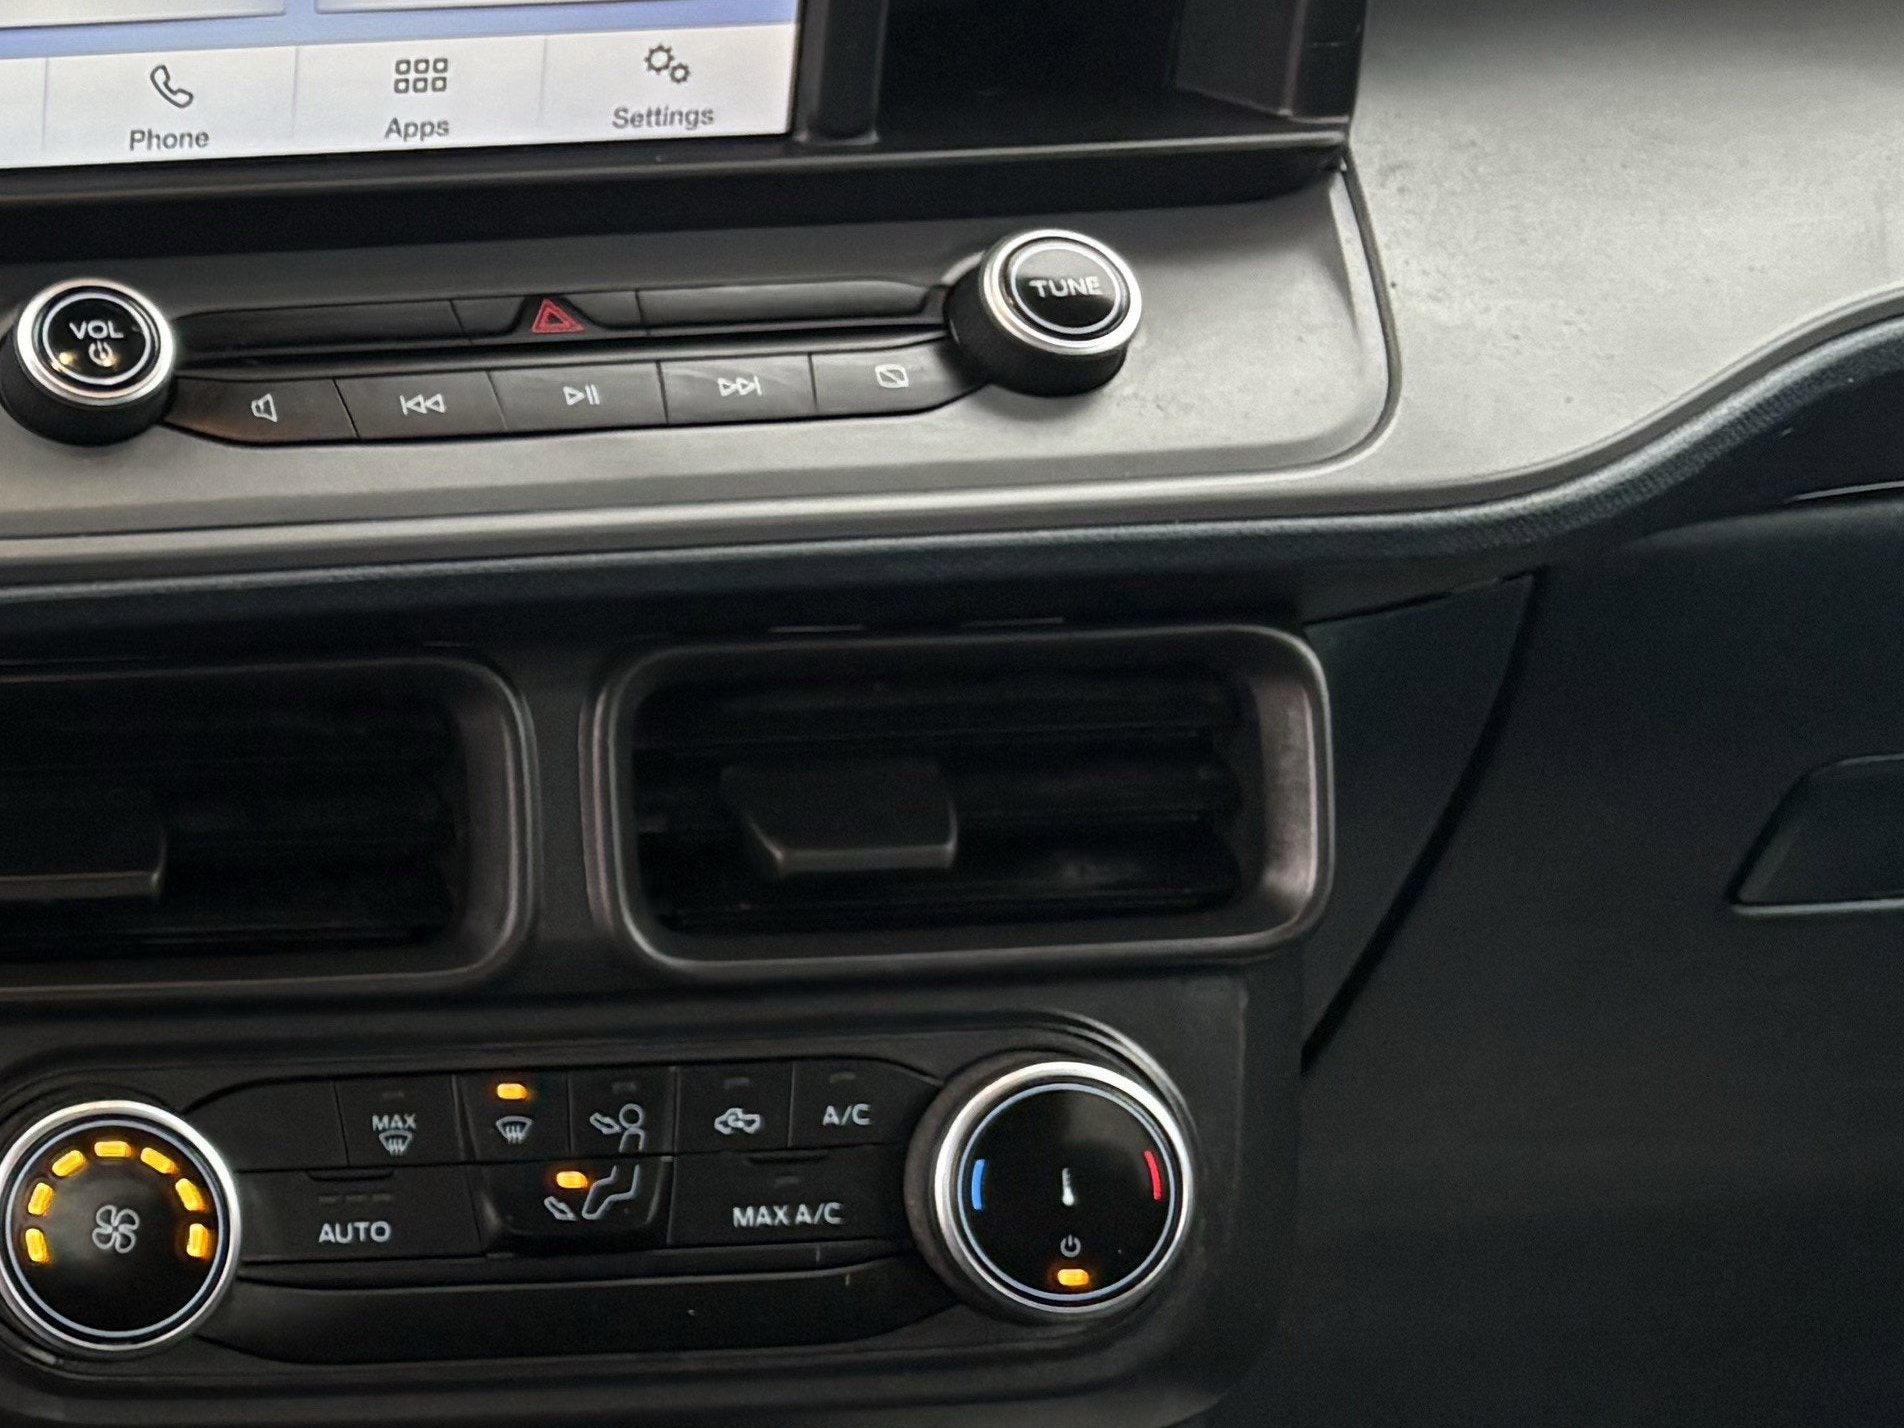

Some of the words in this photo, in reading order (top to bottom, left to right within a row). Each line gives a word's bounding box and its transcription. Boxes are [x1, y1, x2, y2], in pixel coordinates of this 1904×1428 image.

[384, 114, 451, 145] Apps
[610, 101, 717, 135] Settings
[127, 125, 210, 153] Phone
[1030, 274, 1103, 300] TUNE
[68, 318, 122, 343] VOL
[371, 1115, 418, 1133] MAX
[820, 1102, 872, 1128] A/C
[732, 1204, 789, 1228] MAX
[791, 1200, 843, 1227] A/C
[317, 1220, 391, 1245] AUTO
